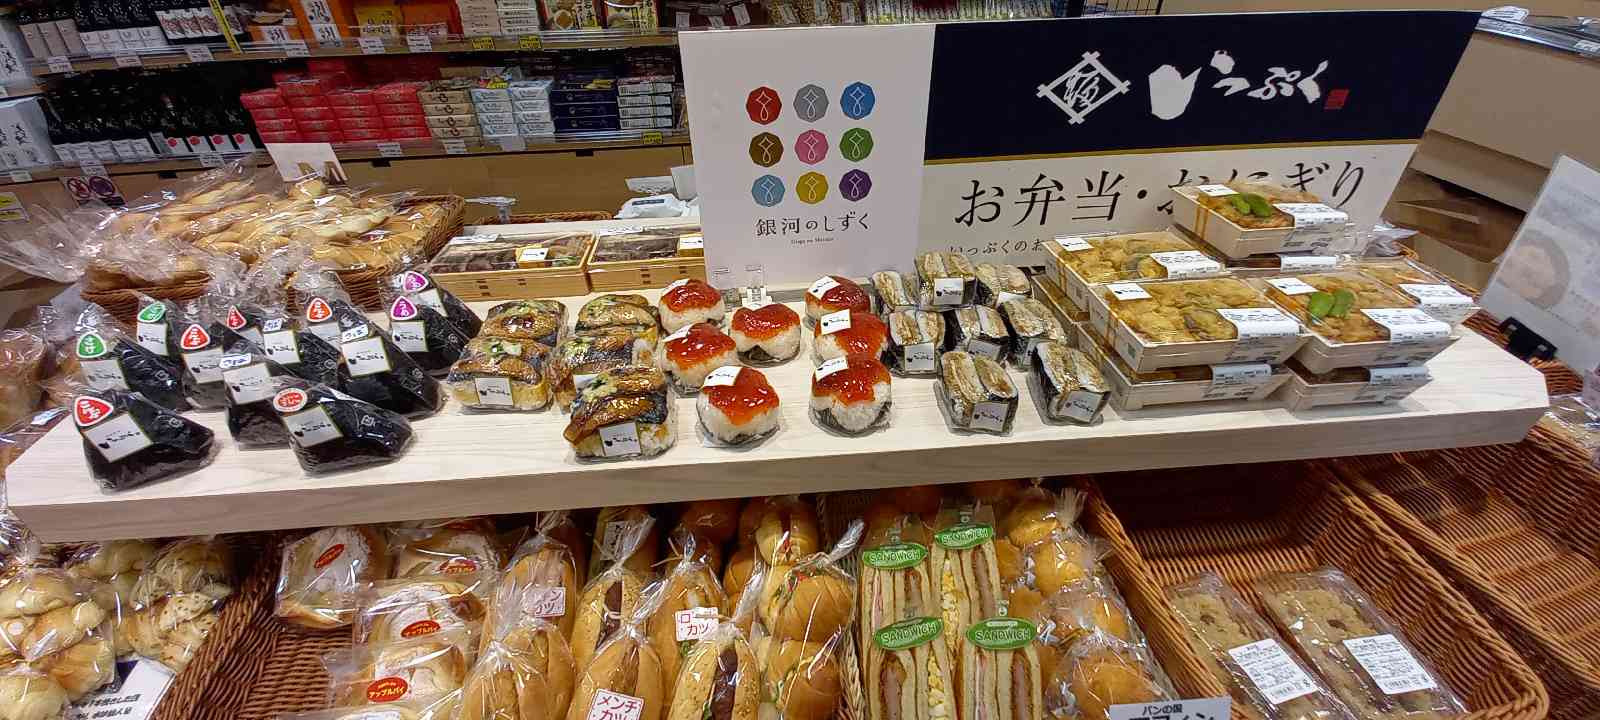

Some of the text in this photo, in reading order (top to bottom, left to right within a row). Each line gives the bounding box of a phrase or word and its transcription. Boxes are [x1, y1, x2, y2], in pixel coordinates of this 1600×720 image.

[756, 211, 869, 236] 銀河のしずく
[870, 550, 921, 562] SANDWICH
[688, 623, 709, 635] カツ
[881, 622, 937, 643] SANDWICH
[976, 629, 1030, 641] SANDWICH
[369, 687, 404, 699] アップルパイ
[597, 696, 637, 714] メンチ
